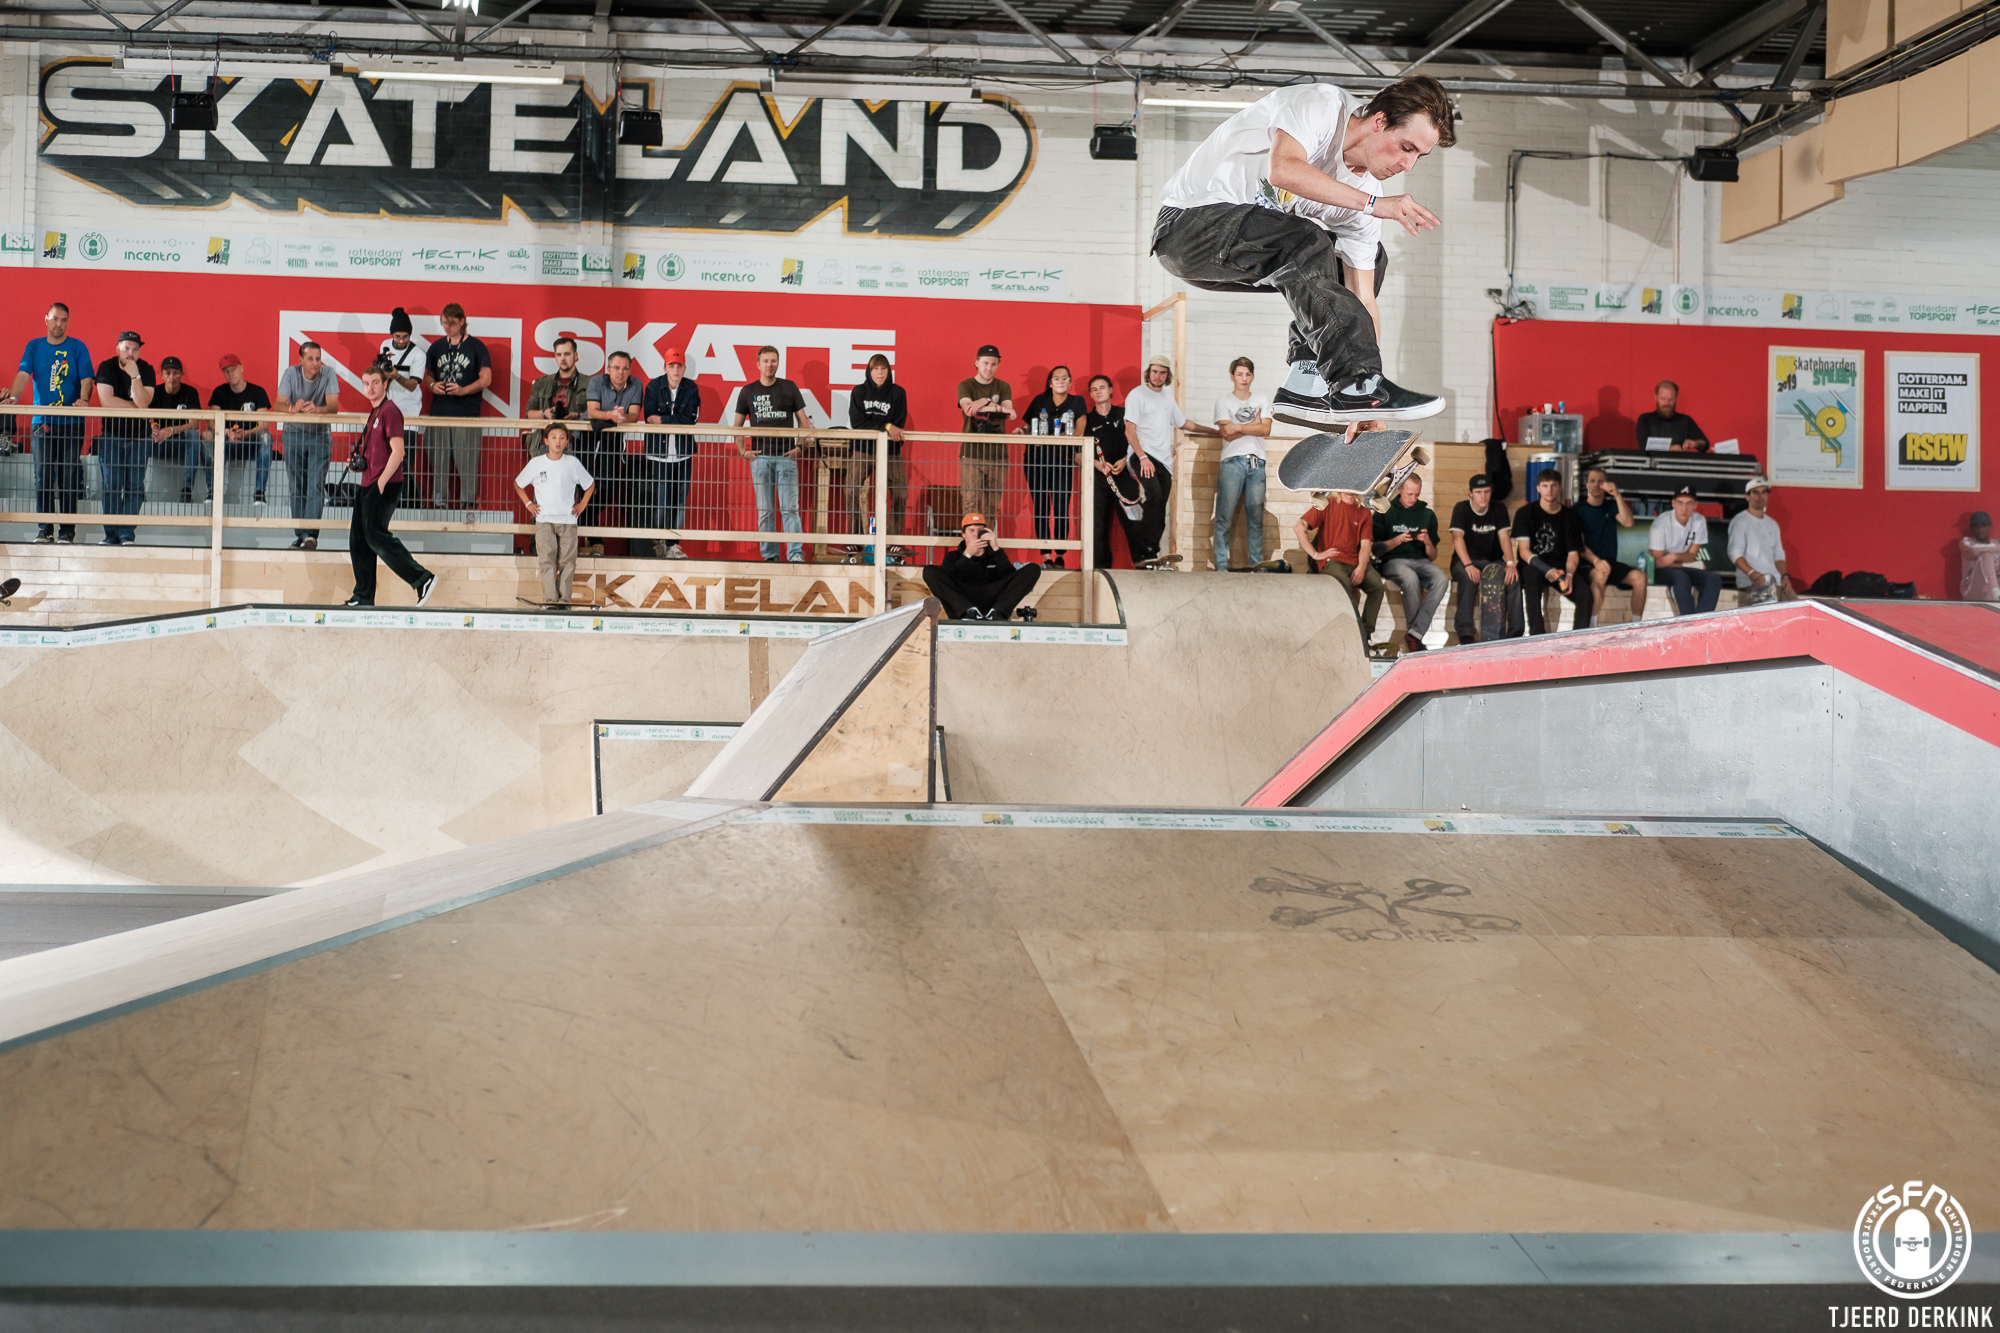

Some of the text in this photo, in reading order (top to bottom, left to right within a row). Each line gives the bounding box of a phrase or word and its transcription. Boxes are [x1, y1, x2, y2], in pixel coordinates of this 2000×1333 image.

[40, 64, 1029, 193] SKATELAND
[124, 251, 181, 262] incentro
[349, 249, 402, 257] rotterdam
[412, 248, 499, 260] HECTIK
[349, 257, 401, 267] TOPSPORT
[424, 264, 485, 272] SKATELAND
[701, 272, 756, 283] incentro
[918, 270, 970, 278] rotterdam
[979, 268, 1063, 280] HECTIK
[918, 277, 969, 287] TOPSPORT
[991, 284, 1049, 292] SKATELAND
[1708, 307, 1758, 317] incentro
[1909, 304, 1957, 313] rotterdam
[1909, 312, 1957, 322] TOPSPORT
[533, 317, 896, 387] SKATE
[1776, 356, 1856, 381] NK skateboarden
[1777, 373, 1797, 392] 2019
[1813, 368, 1857, 387] STREET
[1899, 374, 1966, 385] ROTTERDAM.
[1899, 388, 1944, 399] MAKE IT
[1899, 402, 1946, 413] HAPPEN.
[1903, 433, 1968, 463] RSCW
